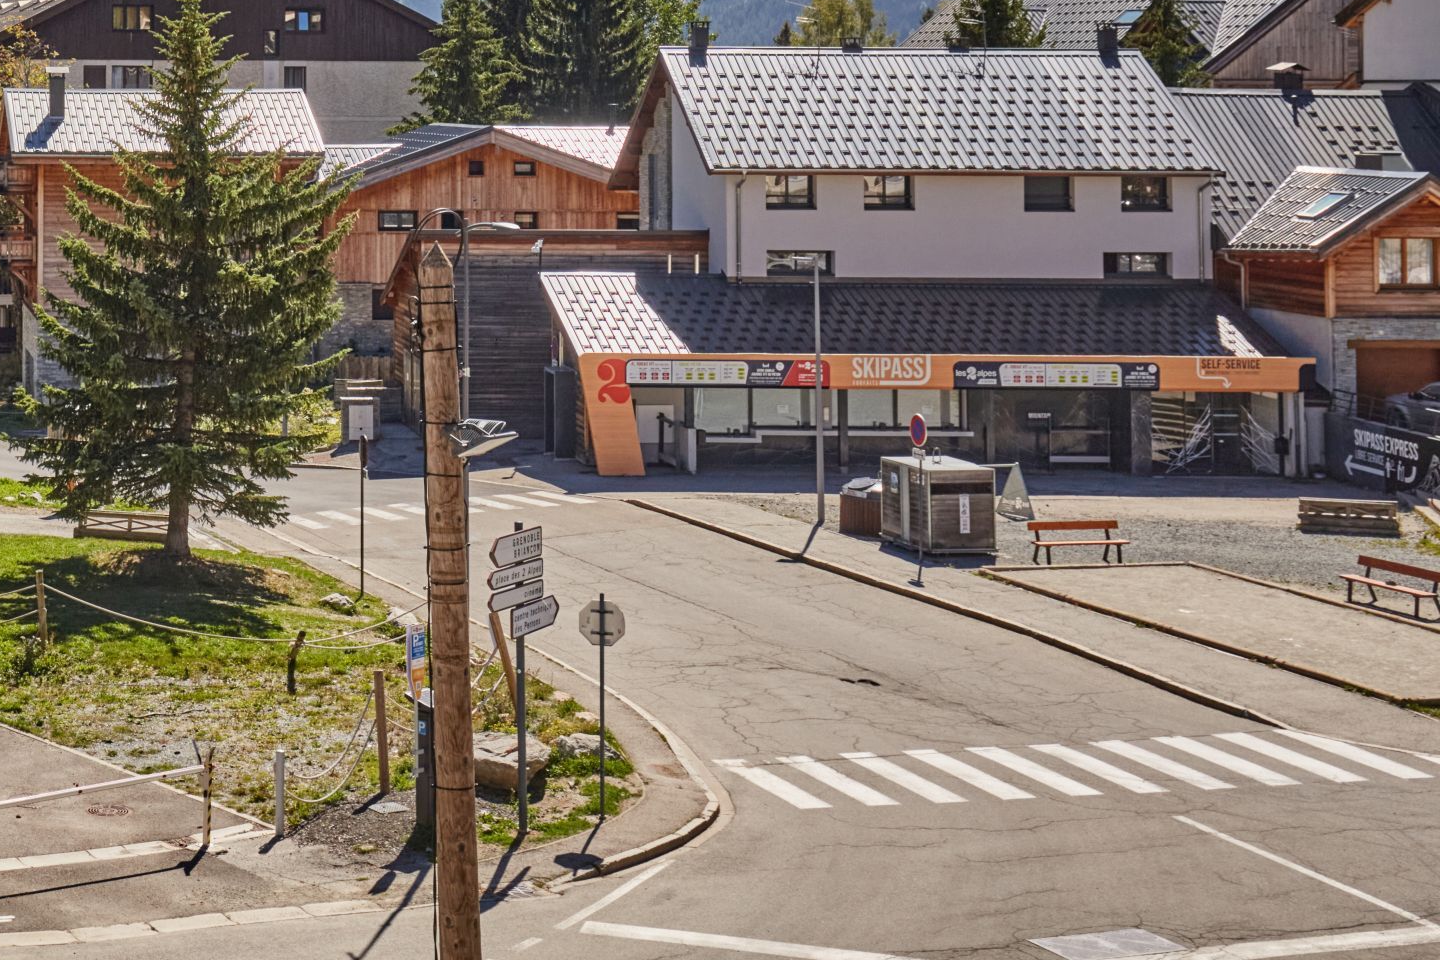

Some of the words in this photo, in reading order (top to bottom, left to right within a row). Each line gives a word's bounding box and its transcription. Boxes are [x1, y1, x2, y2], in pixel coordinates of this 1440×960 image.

[852, 357, 924, 379] SKIPASS
[1201, 359, 1260, 370] SELF-SERVICE
[955, 369, 967, 377] les
[966, 366, 977, 380] 2
[977, 369, 997, 379] alpes
[1354, 428, 1385, 452] SKIPASS
[1384, 436, 1419, 460] EXPRESS
[513, 531, 540, 547] GRENOBLE
[514, 543, 540, 558] BRIANÇON
[495, 575, 510, 585] place
[511, 570, 521, 581] des
[521, 567, 526, 577] 2
